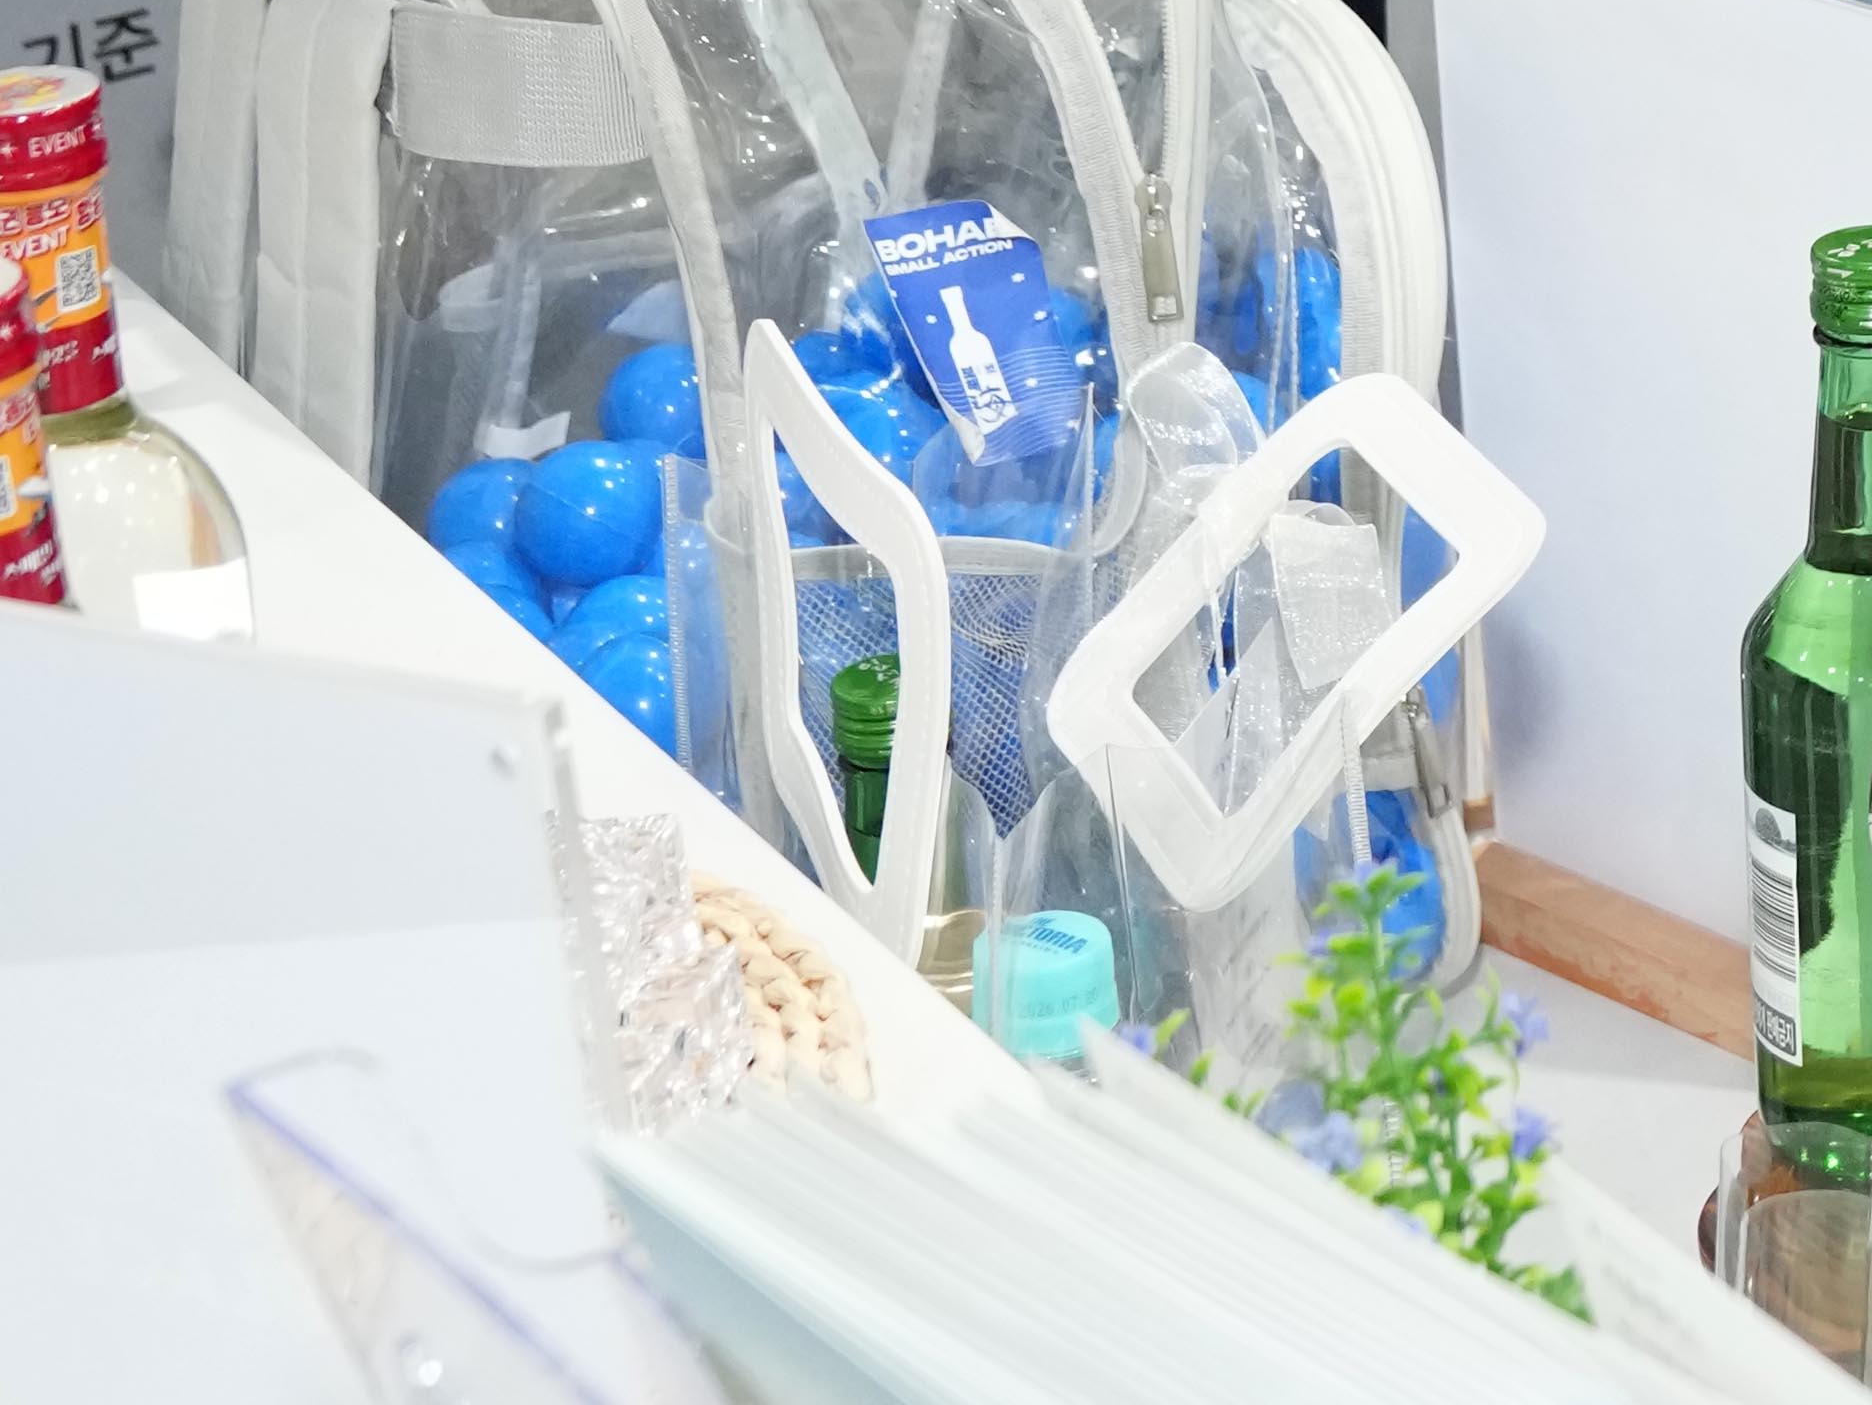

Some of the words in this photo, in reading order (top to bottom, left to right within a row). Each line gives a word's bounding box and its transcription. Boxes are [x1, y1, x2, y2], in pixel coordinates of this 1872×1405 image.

[24, 7, 160, 86] 기준
[28, 124, 87, 158] EVENT
[884, 256, 941, 277] SMALL
[942, 238, 1014, 266] ACTION
